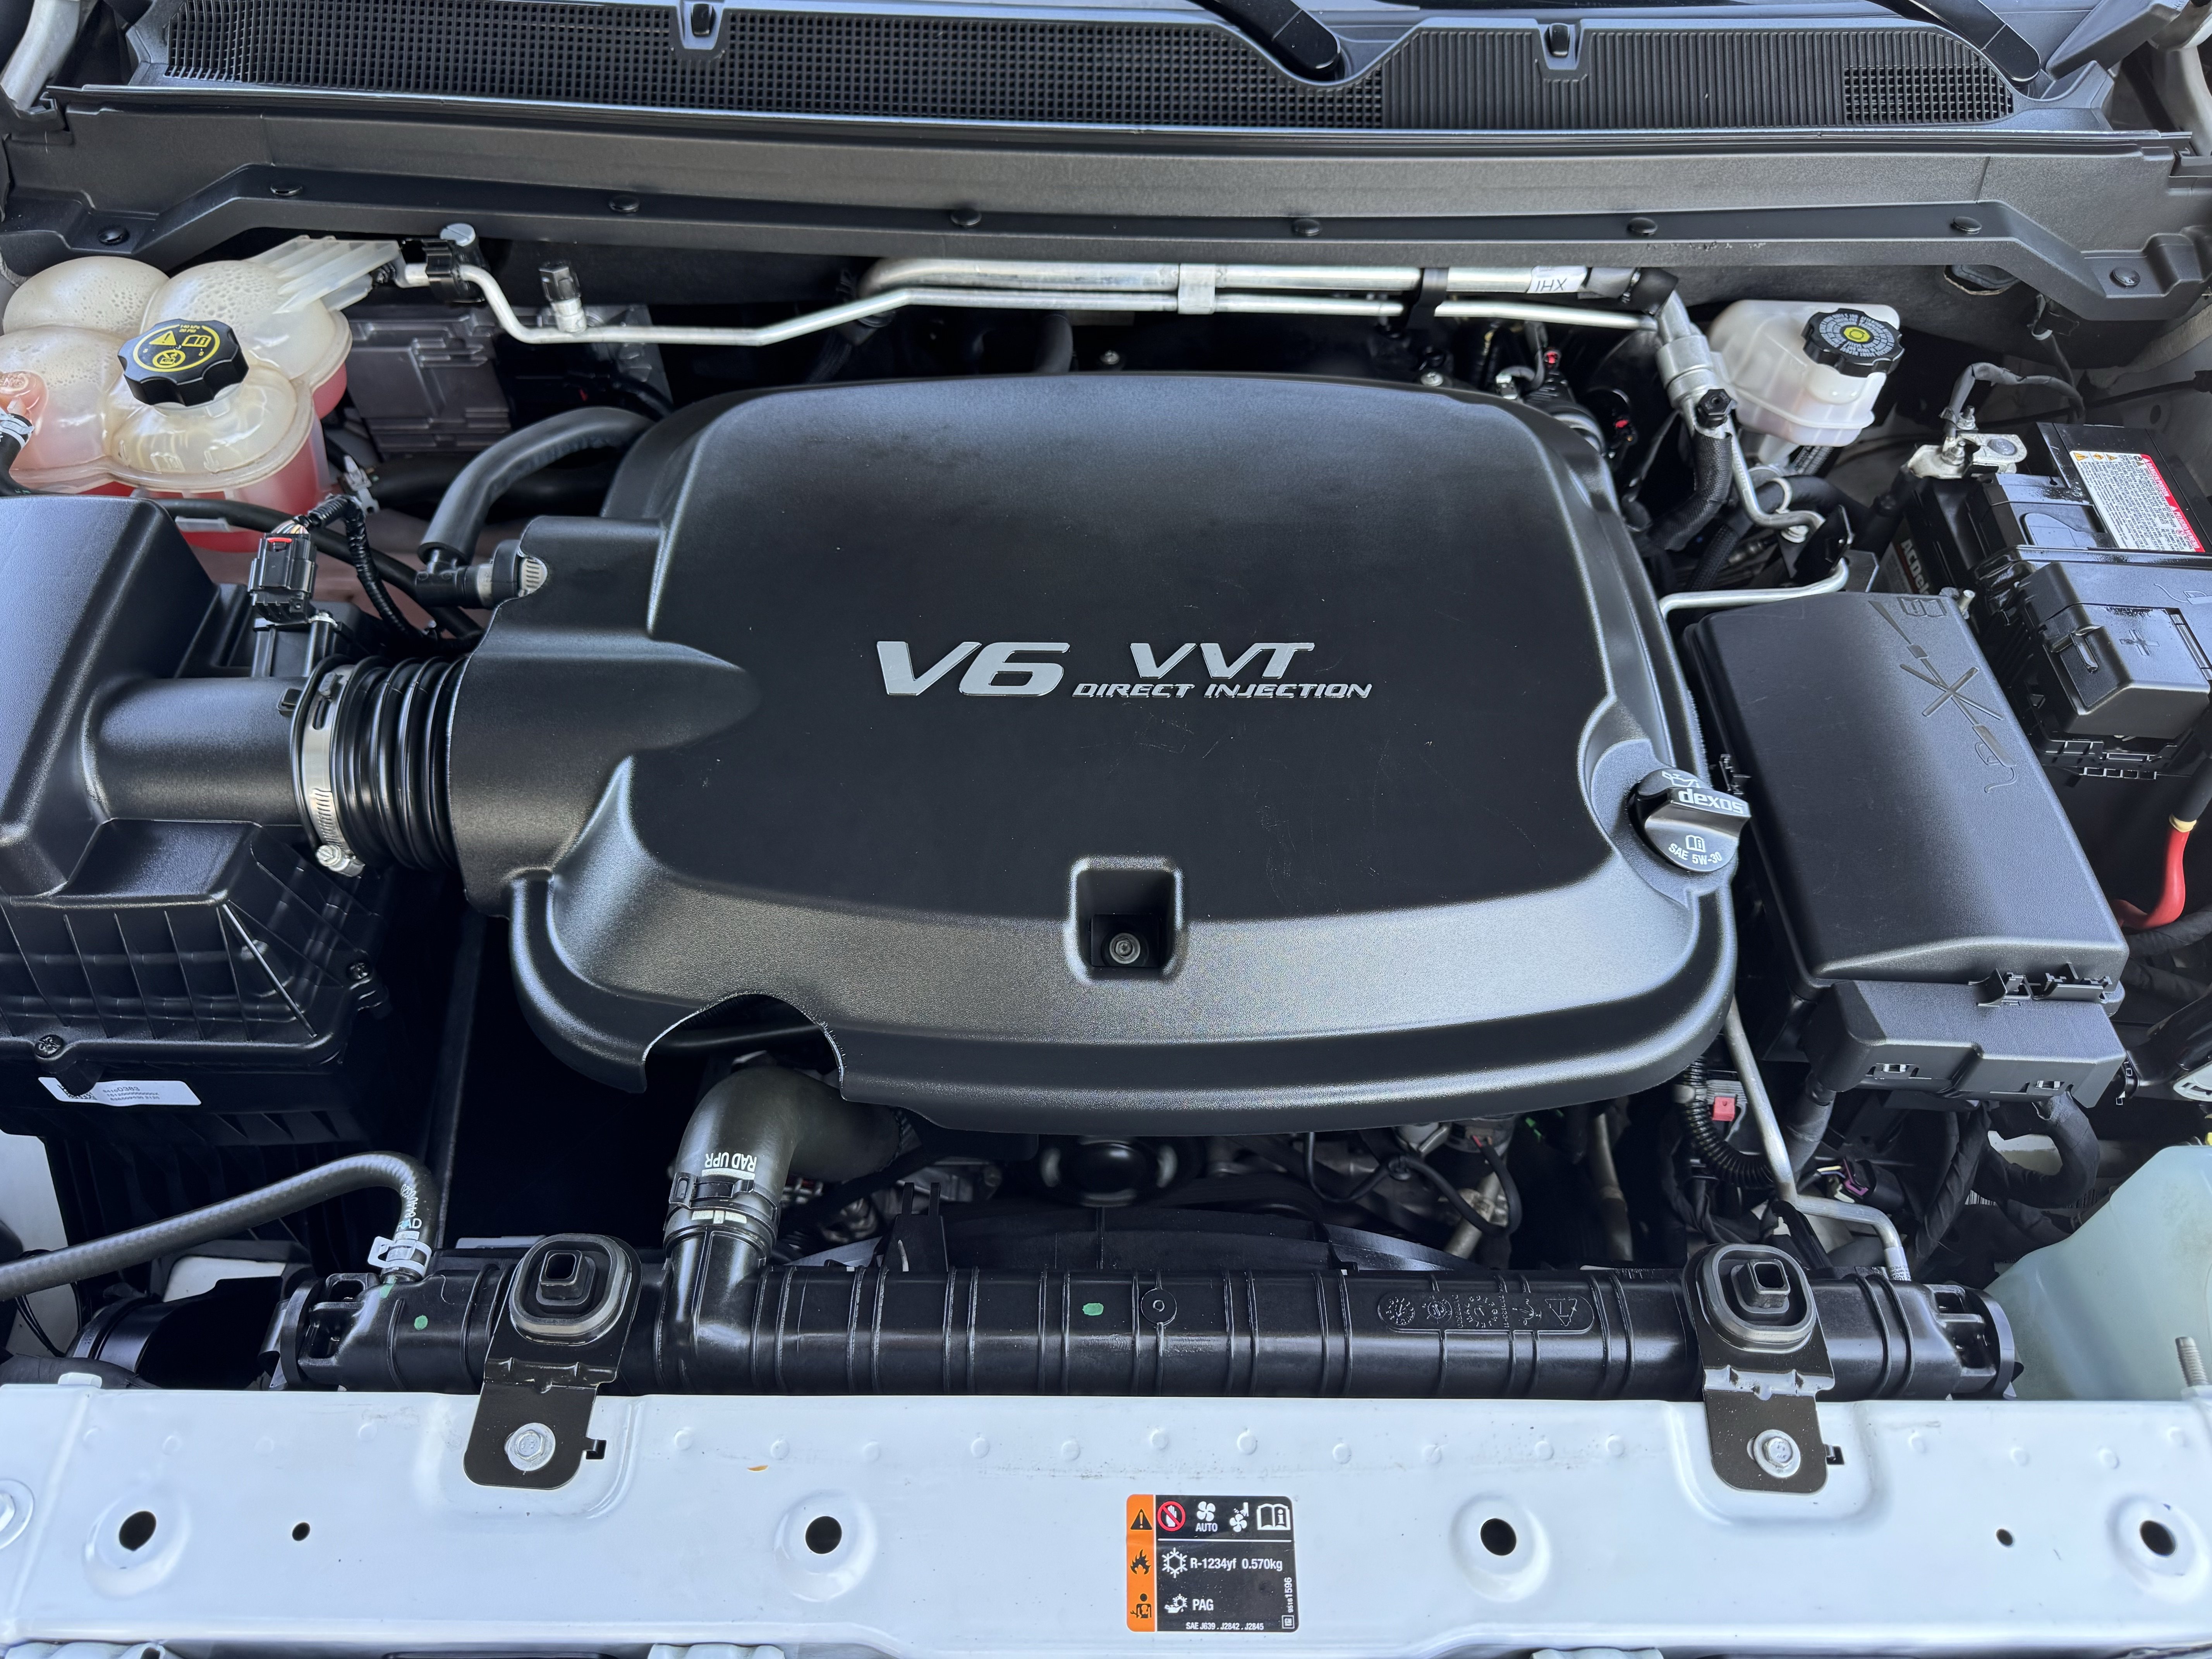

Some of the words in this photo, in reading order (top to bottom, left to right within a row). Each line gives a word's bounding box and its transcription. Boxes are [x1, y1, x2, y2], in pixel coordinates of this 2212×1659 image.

[1535, 278, 1567, 292] IHX
[2145, 462, 2171, 497] DANGER/POISON
[2173, 511, 2201, 549] PELIGRO/VENENO
[1900, 539, 1929, 594] ACDel
[877, 641, 1071, 696] V6
[1130, 643, 1315, 679] VVT
[1072, 684, 1195, 698] DIRECT
[1204, 684, 1372, 698] INJECTION
[1678, 788, 1743, 814] dexos
[1668, 843, 1689, 860] SAE
[1692, 852, 1723, 865] 5W-30
[704, 1152, 730, 1168] UPR
[731, 1152, 757, 1172] RAD
[1195, 1523, 1218, 1532] AUTO
[1190, 1558, 1237, 1571] R-1234yf
[1242, 1558, 1283, 1571] 0.570kg
[1192, 1599, 1214, 1611] PAG
